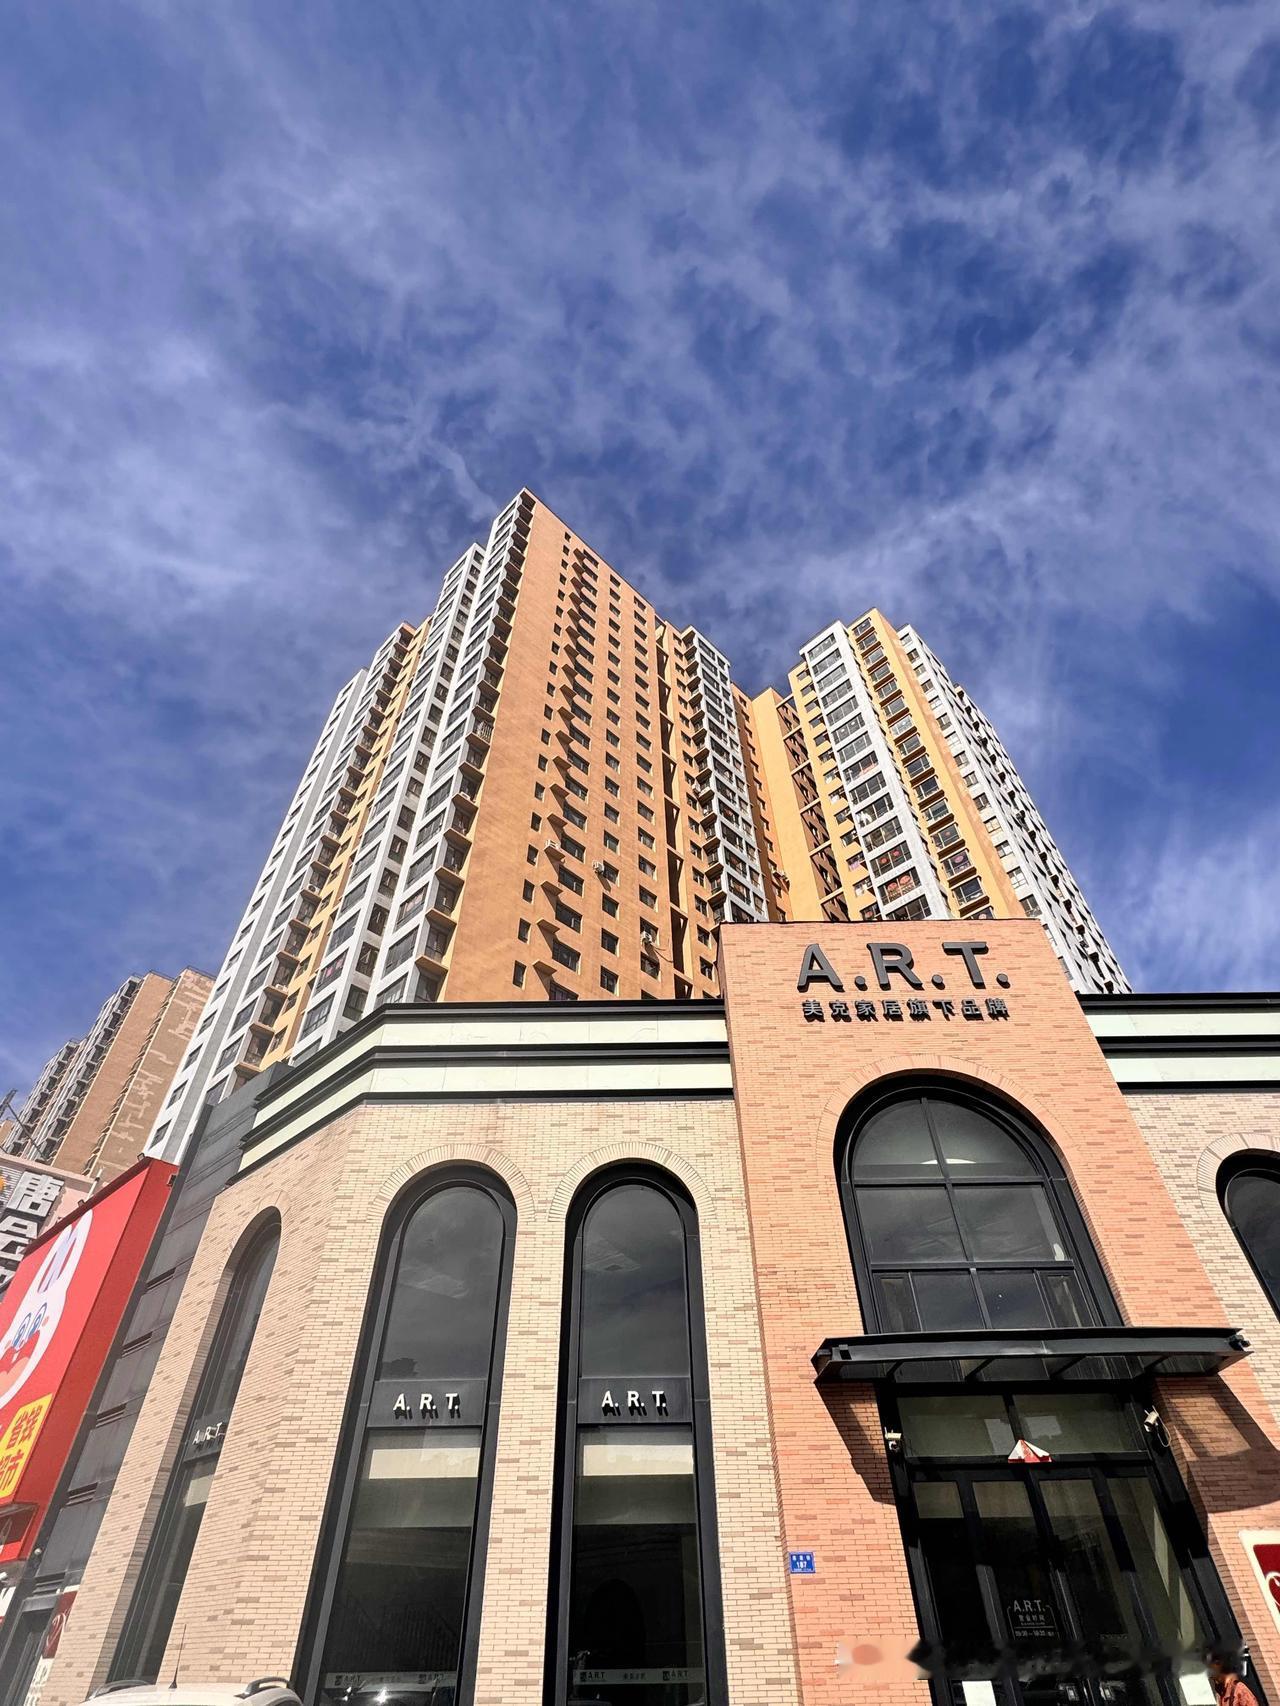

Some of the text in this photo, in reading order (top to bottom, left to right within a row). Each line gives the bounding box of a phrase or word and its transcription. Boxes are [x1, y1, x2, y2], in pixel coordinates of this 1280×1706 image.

[797, 941, 1010, 992] A.R.T.
[801, 998, 1010, 1019] 美克家居旗下品牌
[393, 1392, 459, 1411] A.R.T.
[601, 1390, 667, 1408] A.R.T.
